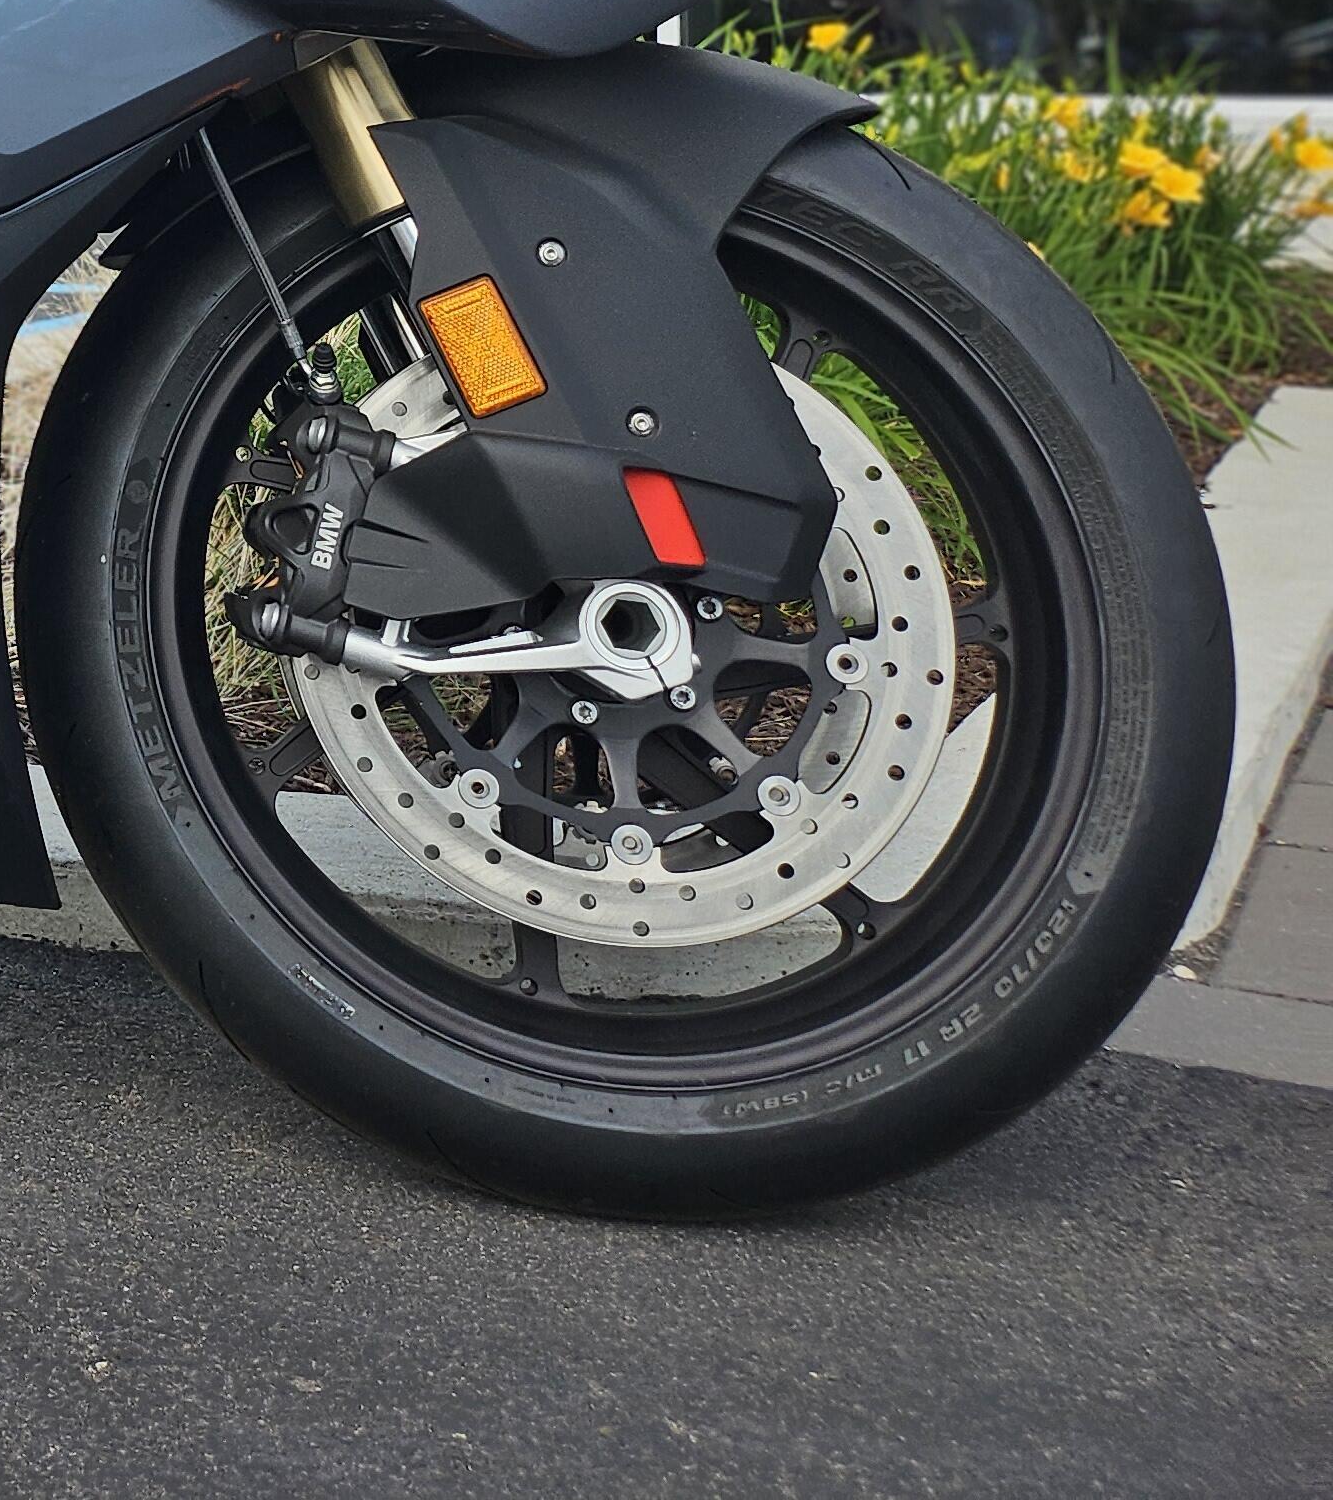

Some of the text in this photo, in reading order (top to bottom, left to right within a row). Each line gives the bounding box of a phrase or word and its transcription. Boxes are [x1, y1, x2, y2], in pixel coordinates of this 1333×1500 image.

[311, 502, 344, 570] BMW
[113, 529, 184, 803] METZELER
[993, 899, 1078, 998] 120/70
[904, 1039, 930, 1065] 17
